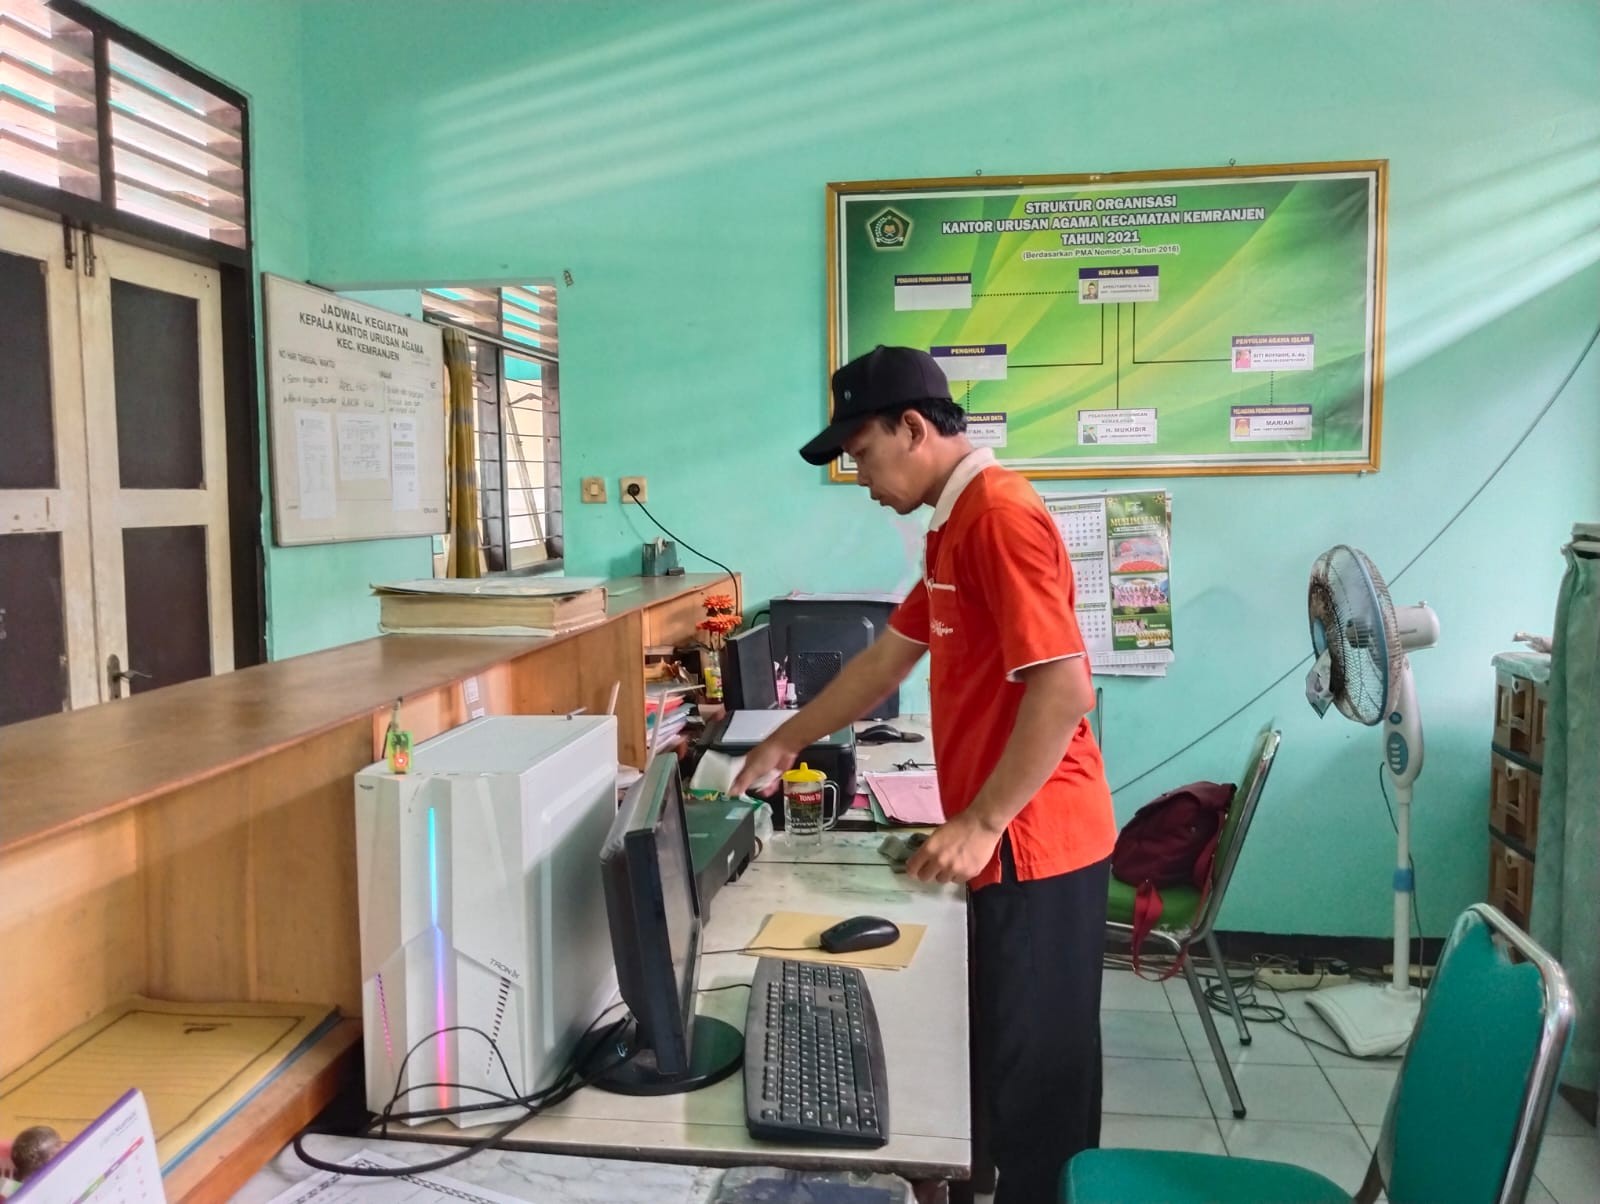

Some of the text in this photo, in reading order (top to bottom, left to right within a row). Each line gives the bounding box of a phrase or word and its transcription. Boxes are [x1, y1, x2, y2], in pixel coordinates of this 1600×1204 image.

[1025, 195, 1177, 214] STRUKTUR ORGANISASI
[942, 208, 1265, 234] KANTOR URUSAN AGAMA KECAMATAN KEMRANJEN
[1062, 231, 1140, 245] TAHUN 2021
[1023, 252, 1073, 260] (Berdasarkan
[1095, 248, 1121, 256] Nomor
[320, 303, 409, 337] JADWAL KEGIATAN
[299, 311, 424, 355] KEPALA KANTOR URUSAN AGAMA
[336, 337, 400, 361] KEC. KEMRANJEN
[950, 347, 986, 355] PENGHULU
